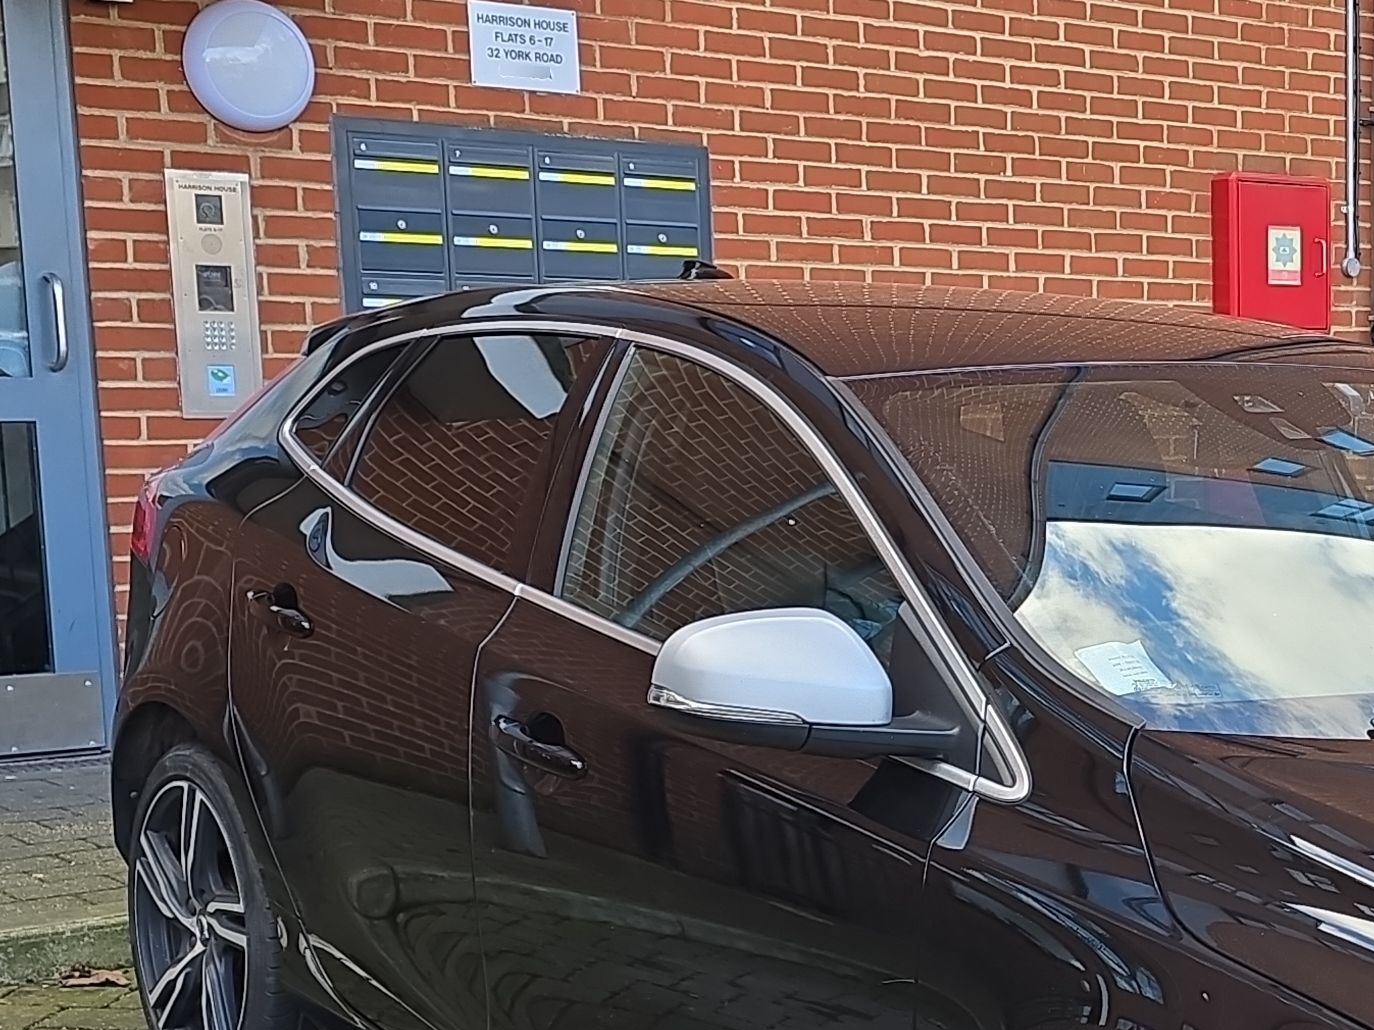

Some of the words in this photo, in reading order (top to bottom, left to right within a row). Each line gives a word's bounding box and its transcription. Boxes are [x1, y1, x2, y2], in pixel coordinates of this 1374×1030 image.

[476, 13, 531, 28] HARRISON
[533, 19, 569, 33] HOUSE
[494, 31, 527, 45] FLATS
[487, 47, 501, 59] 32
[503, 49, 532, 62] YORK
[534, 52, 563, 65] ROAD
[178, 183, 212, 191] HARRISON
